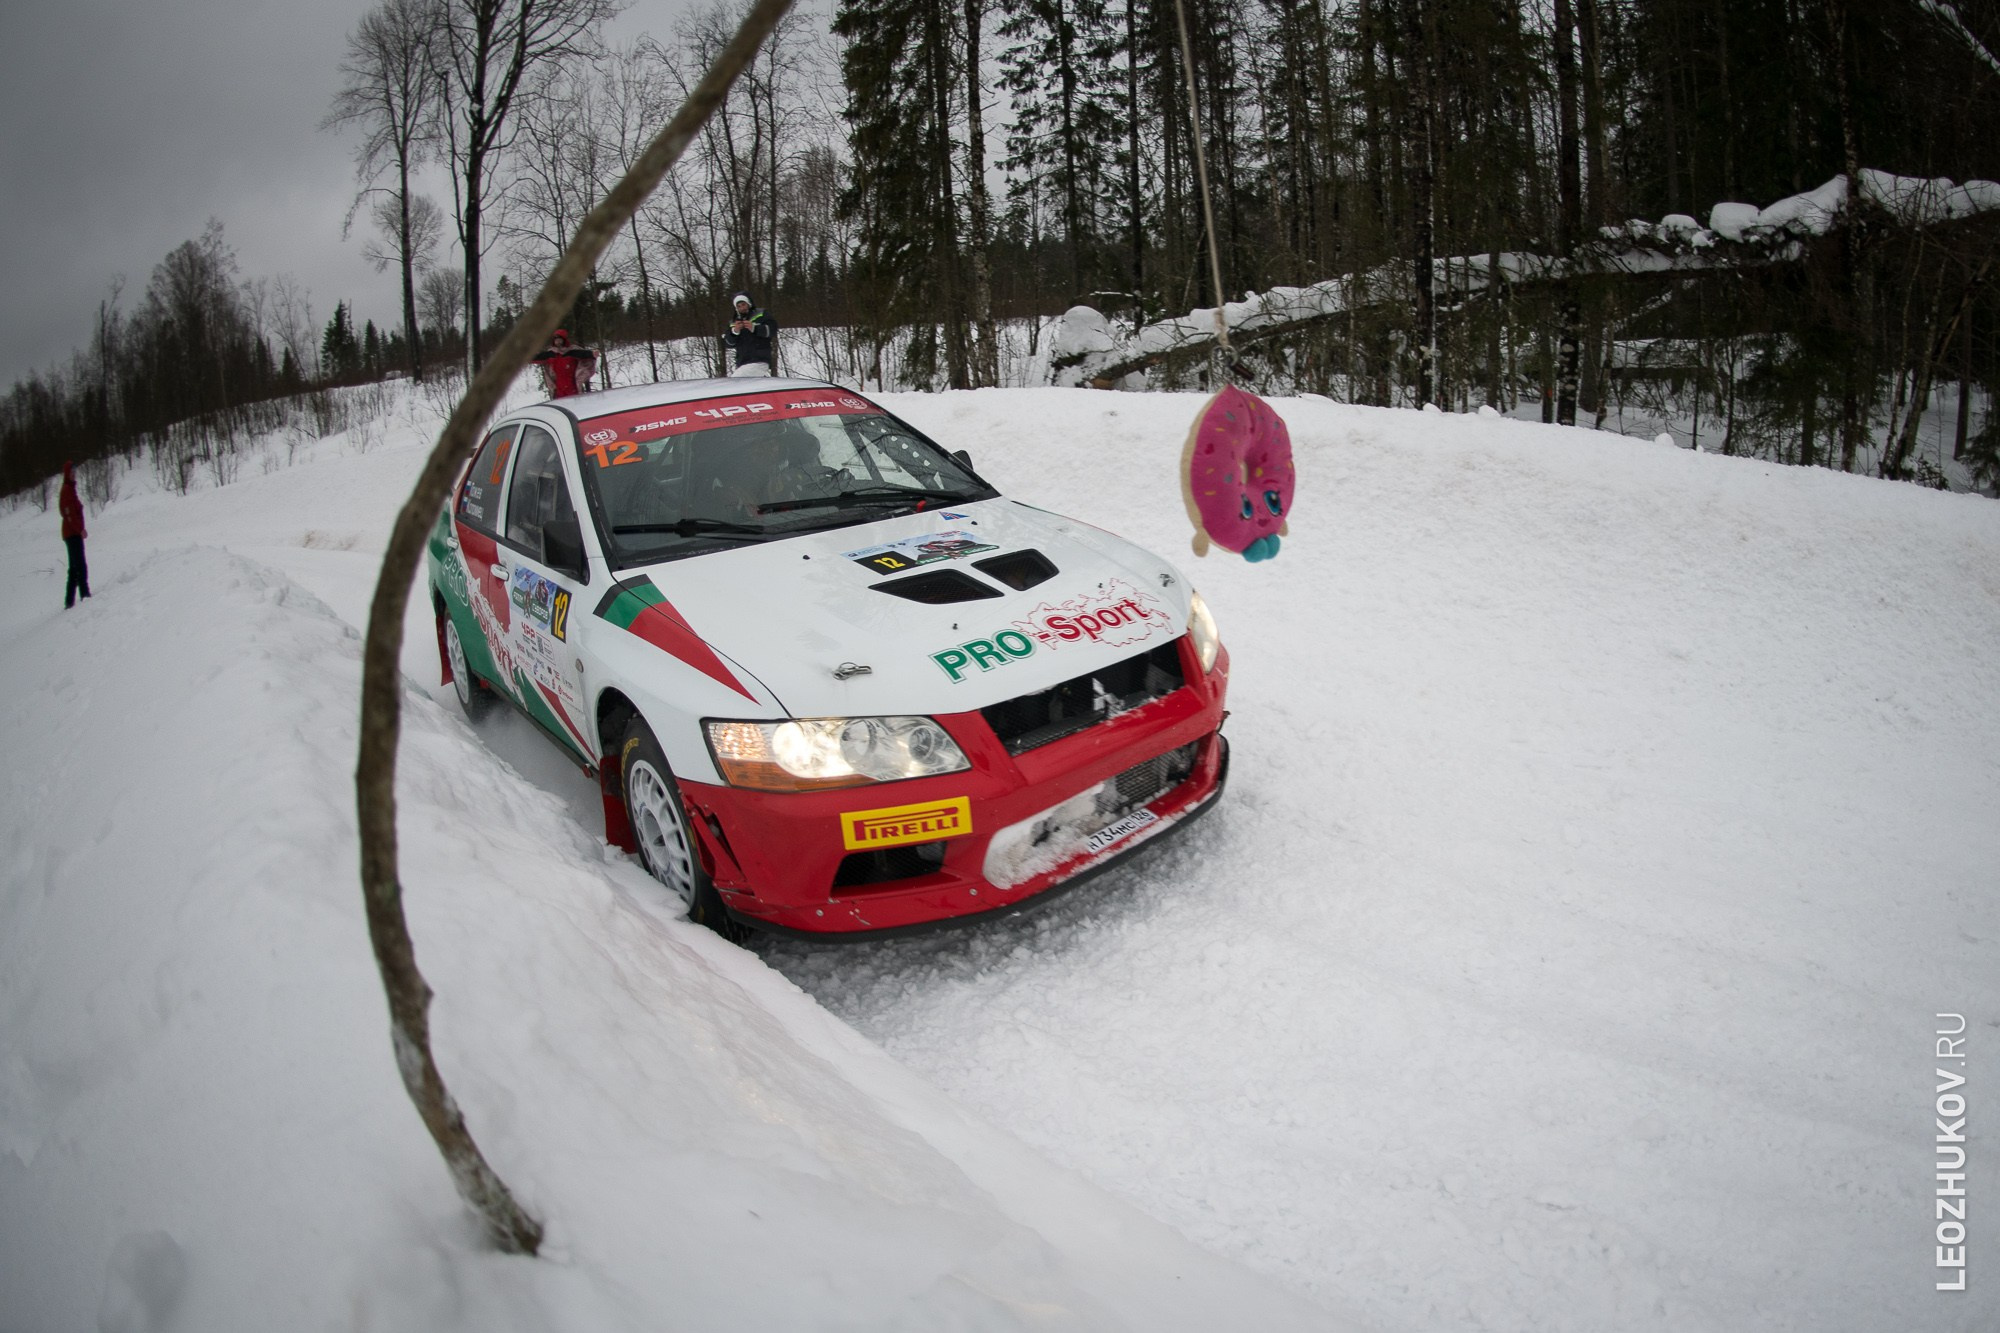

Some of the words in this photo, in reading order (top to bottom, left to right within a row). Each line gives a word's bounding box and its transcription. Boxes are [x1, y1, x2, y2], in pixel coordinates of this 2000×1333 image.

[635, 416, 687, 433] ASMG
[789, 401, 835, 410] ASMG
[490, 438, 510, 484] 12
[585, 440, 642, 468] 12
[873, 557, 906, 569] 12
[554, 592, 568, 640] 12
[932, 598, 1150, 682] PRO-Sport
[853, 806, 959, 841] PIRELLI
